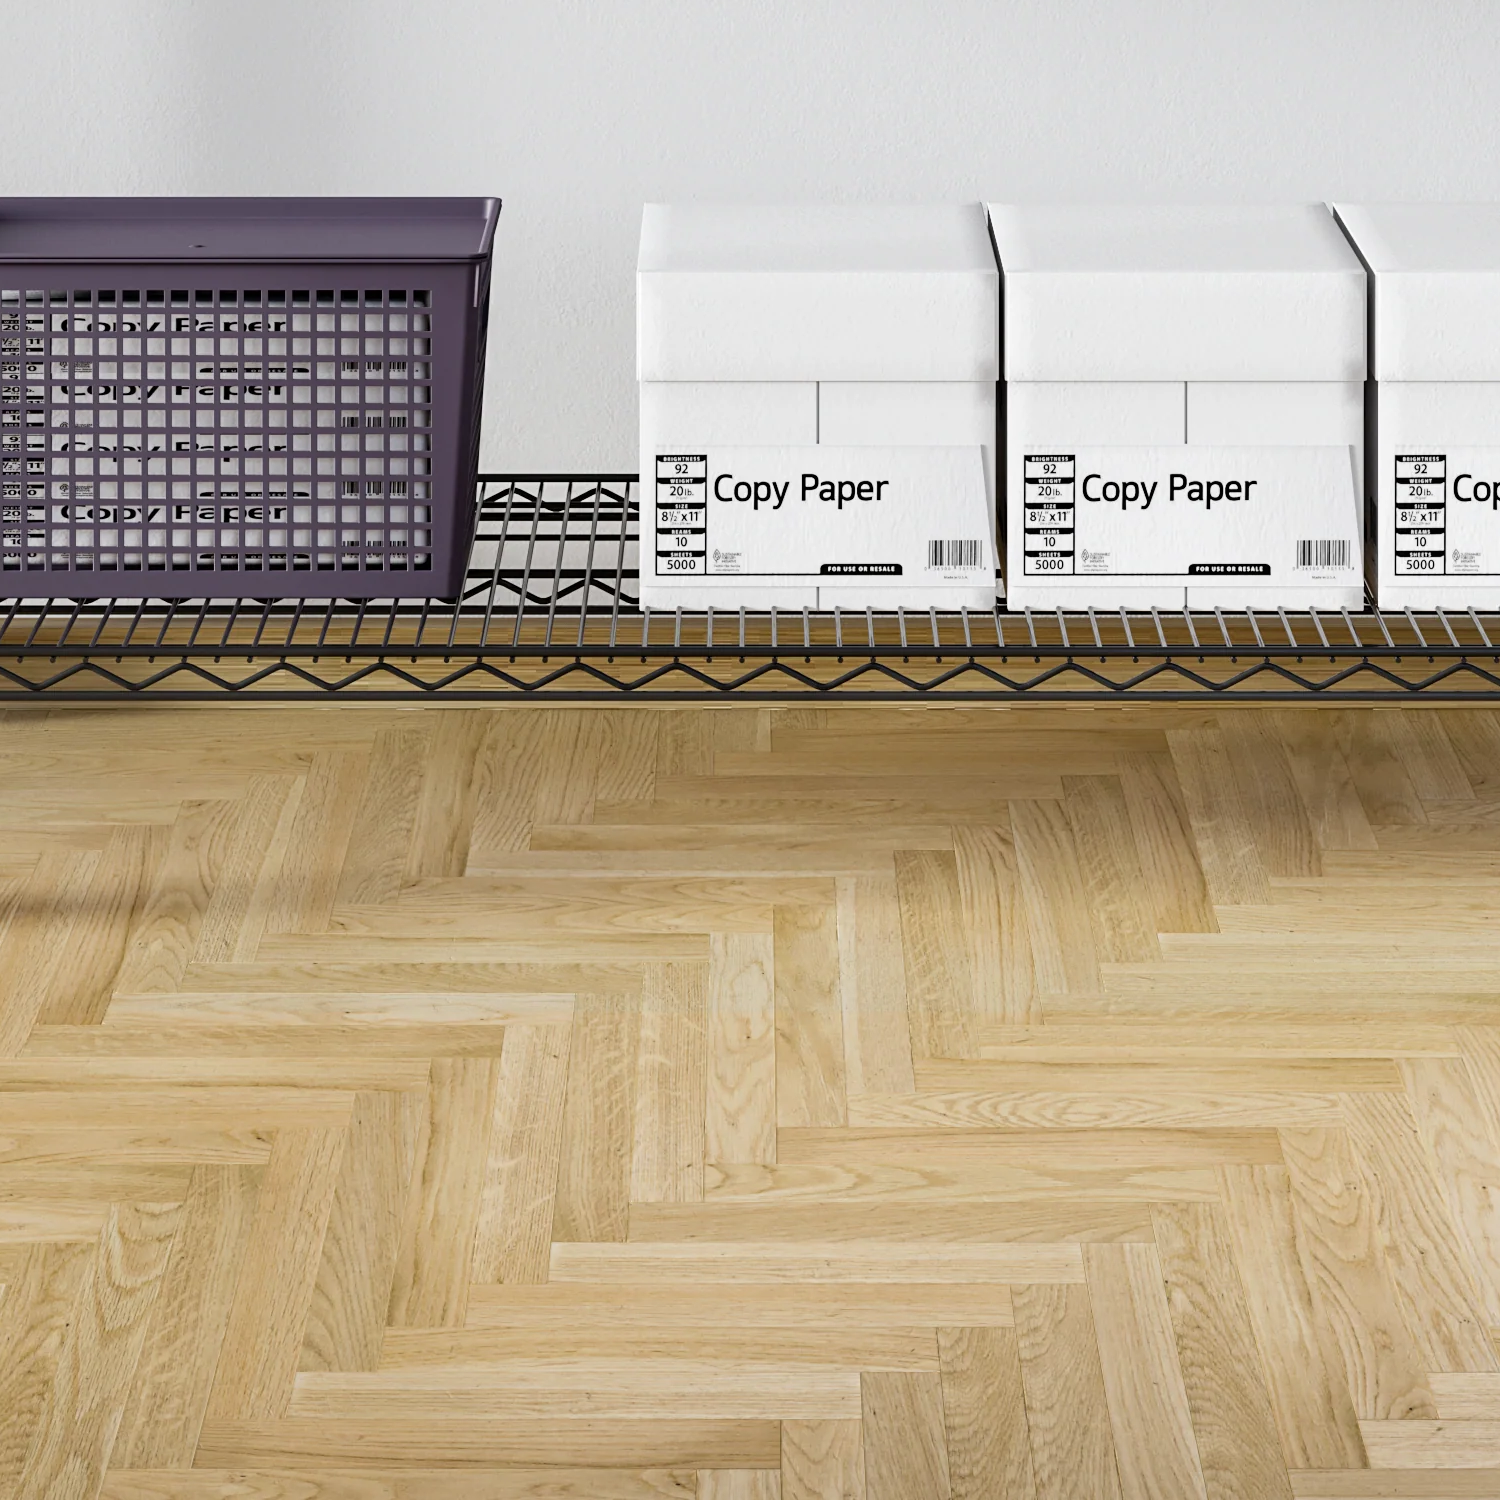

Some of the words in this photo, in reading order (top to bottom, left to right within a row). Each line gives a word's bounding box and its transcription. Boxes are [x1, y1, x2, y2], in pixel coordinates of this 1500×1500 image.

[674, 463, 689, 475] 92
[1042, 463, 1057, 475] 92
[1413, 463, 1428, 475] 92
[713, 473, 791, 511] Copy
[801, 473, 890, 511] Paper
[1081, 473, 1159, 511] Copy
[1169, 473, 1258, 511] Paper
[675, 536, 688, 547] 10
[1043, 536, 1056, 547] 10
[1414, 536, 1427, 547] 10
[666, 559, 696, 570] 5000
[827, 565, 842, 573] FOR
[842, 565, 857, 573] USE
[858, 565, 868, 573] OR
[1034, 559, 1064, 570] 5000
[1195, 565, 1210, 573] FOR
[1210, 565, 1225, 573] USE
[1226, 565, 1236, 573] OR
[1405, 559, 1435, 570] 5000
